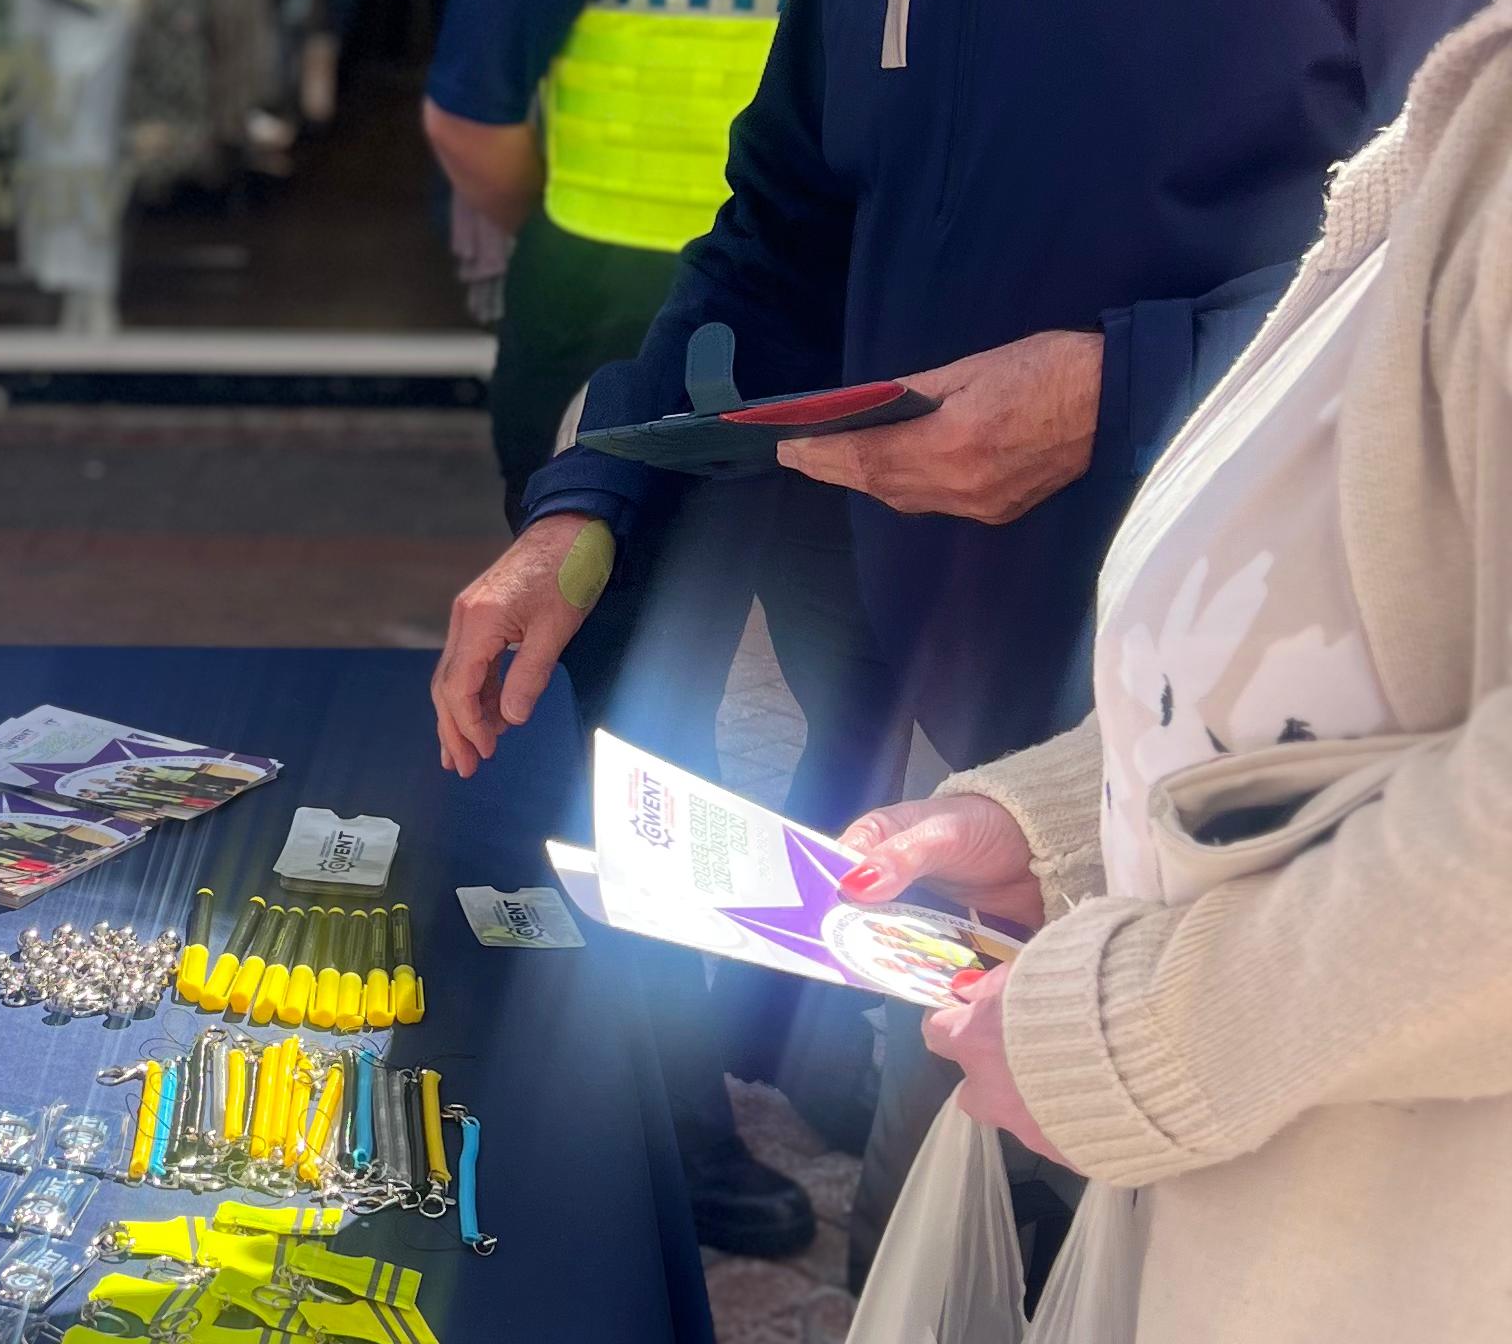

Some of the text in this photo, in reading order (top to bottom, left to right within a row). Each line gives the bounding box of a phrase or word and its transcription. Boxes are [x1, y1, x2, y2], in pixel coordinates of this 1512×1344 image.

[643, 771, 662, 840] GWENT
[328, 830, 355, 871] GWENT
[502, 900, 533, 938] GWENT
